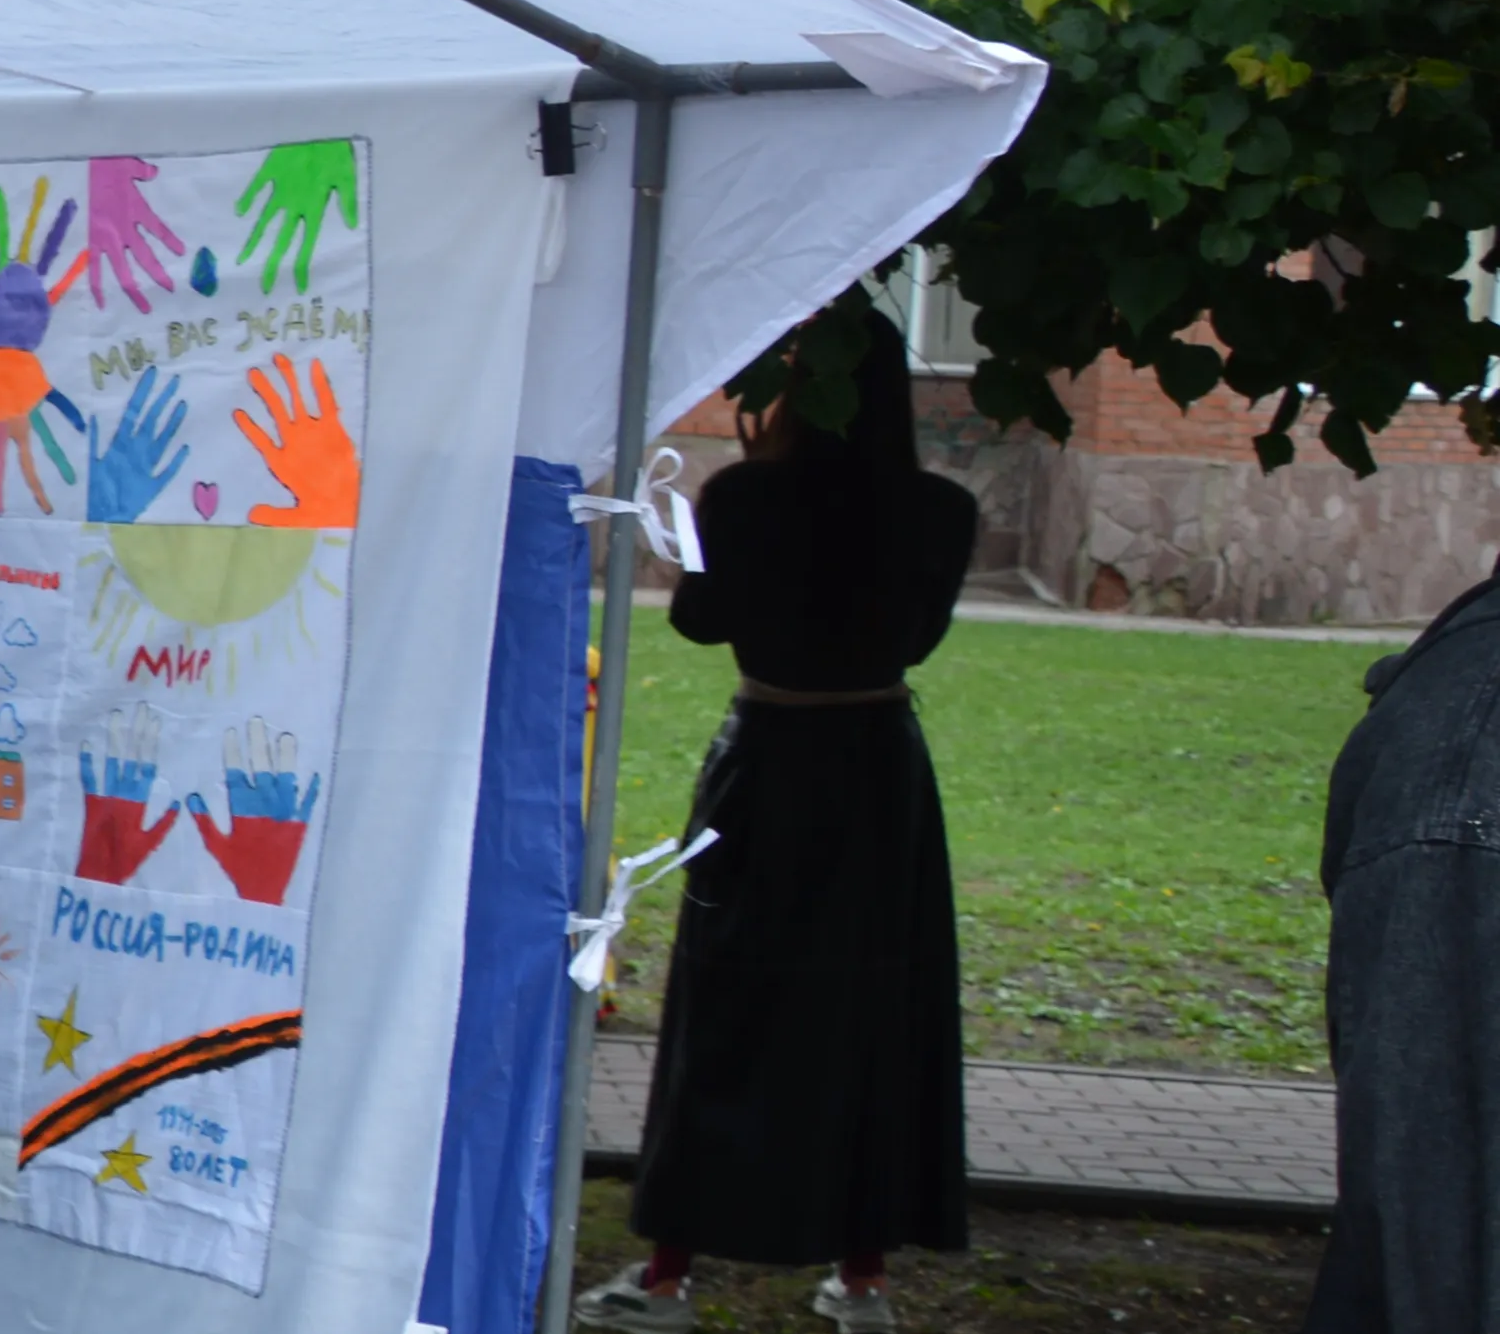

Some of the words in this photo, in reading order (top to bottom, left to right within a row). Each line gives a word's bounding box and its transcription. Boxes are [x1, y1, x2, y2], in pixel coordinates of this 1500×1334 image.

[166, 316, 218, 359] ВАС
[126, 643, 211, 689] МИР
[169, 1145, 196, 1174] 80
